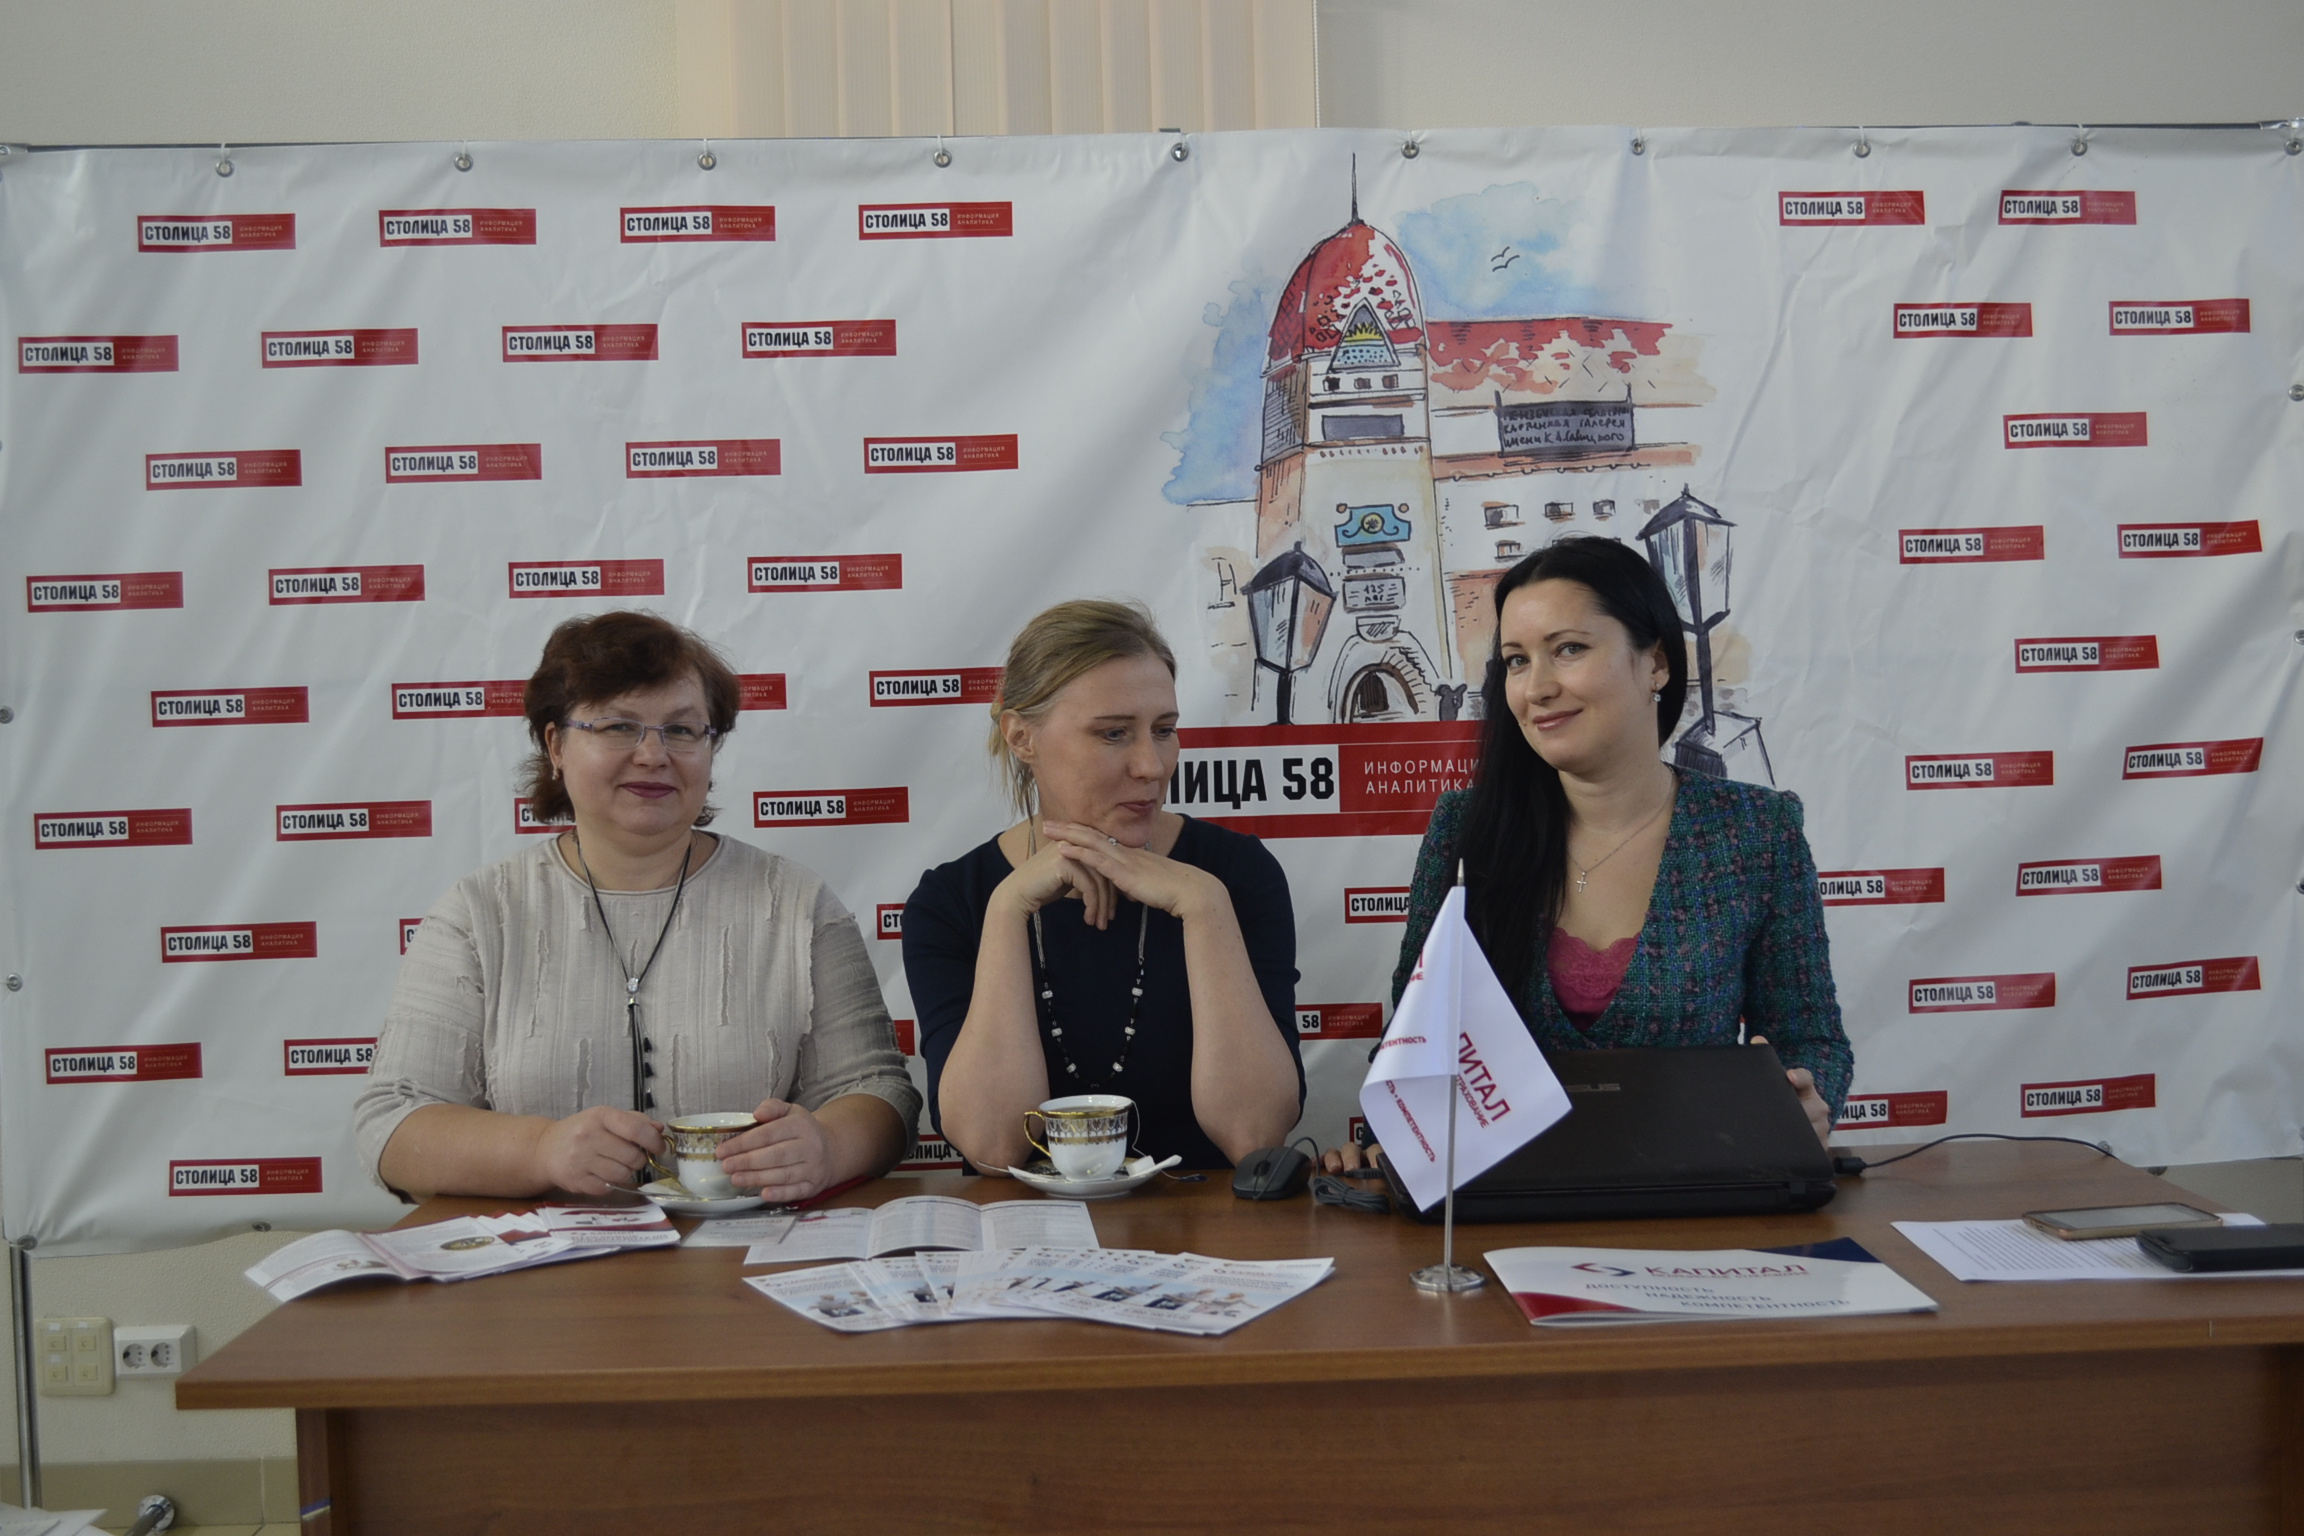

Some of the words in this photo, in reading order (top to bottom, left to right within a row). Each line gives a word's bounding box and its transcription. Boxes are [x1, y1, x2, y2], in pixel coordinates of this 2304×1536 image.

[1785, 201, 1843, 217] СТОЛИЦА
[1847, 201, 1863, 215] 58
[2002, 201, 2058, 216] СТОЛИЦА
[2062, 200, 2079, 214] 58
[386, 219, 448, 236] СТОЛИЦА
[453, 219, 471, 233] 58
[627, 216, 688, 233] СТОЛИЦА
[693, 215, 710, 230] 58
[865, 213, 927, 230] СТОЛИЦА
[931, 212, 948, 227] 58
[145, 226, 208, 242] СТОЛИЦА
[214, 225, 231, 239] 58
[1899, 312, 1956, 328] СТОЛИЦА
[1961, 312, 1976, 326] 58
[2115, 311, 2171, 325] СТОЛИЦА
[2175, 310, 2192, 324] 58
[268, 340, 330, 357] СТОЛИЦА
[335, 340, 353, 354] 58
[509, 335, 571, 352] СТОЛИЦА
[575, 335, 593, 349] 58
[748, 331, 810, 348] СТОЛИЦА
[814, 331, 832, 345] 58
[25, 346, 88, 364] СТОЛИЦА
[94, 346, 112, 361] 58
[2010, 423, 2069, 438] СТОЛИЦА
[2073, 422, 2088, 436] 58
[392, 456, 454, 472] СТОЛИЦА
[459, 455, 476, 470] 58
[632, 451, 694, 468] СТОЛИЦА
[698, 450, 716, 465] 58
[870, 446, 932, 464] СТОЛИЦА
[937, 446, 954, 461] 58
[152, 462, 213, 479] СТОЛИЦА
[218, 462, 235, 476] 58
[1905, 538, 1961, 554] СТОЛИЦА
[1965, 537, 1982, 551] 58
[2123, 533, 2179, 549] СТОЛИЦА
[2183, 532, 2199, 546] 58
[515, 571, 578, 588] СТОЛИЦА
[581, 570, 599, 585] 58
[754, 566, 816, 583] СТОЛИЦА
[820, 565, 838, 580] 58
[33, 585, 97, 602] СТОЛИЦА
[102, 584, 119, 599] 58
[275, 577, 337, 594] СТОЛИЦА
[342, 577, 359, 591] 58
[2021, 647, 2078, 663] СТОЛИЦА
[2082, 646, 2098, 660] 58
[876, 679, 938, 697] СТОЛИЦА
[942, 678, 960, 694] 58
[158, 699, 221, 716] СТОЛИЦА
[225, 698, 243, 713] 58
[398, 691, 461, 709] СТОЛИЦА
[465, 691, 483, 706] 58
[1363, 758, 1479, 775] ИНФОРМАЦИ
[2128, 753, 2182, 769] СТОЛИЦА
[2186, 751, 2203, 765] 58
[1282, 757, 1335, 801] 58
[1912, 763, 1971, 780] СТОЛИЦА
[1975, 763, 1992, 777] 58
[760, 800, 823, 817] СТОЛИЦА
[826, 799, 845, 815] 58
[41, 821, 104, 838] СТОЛИЦА
[109, 820, 127, 836] 58
[283, 813, 345, 830] СТОЛИЦА
[349, 812, 367, 827] 58
[2022, 869, 2078, 885] СТОЛИЦА
[2082, 868, 2099, 882] 58
[1819, 880, 1863, 897] ОЛИЦА
[1866, 880, 1884, 894] 58
[168, 935, 229, 952] СТОЛИЦА
[233, 934, 251, 949] 58
[2132, 971, 2182, 989] СТОЛИЦА
[2186, 969, 2201, 984] 58
[1914, 986, 1973, 1003] СТОЛИЦА
[1977, 985, 1994, 999] 58
[1301, 1014, 1320, 1029] 58
[52, 1056, 115, 1073] СТОЛИЦА
[119, 1055, 136, 1070] 58
[290, 1048, 352, 1065] СТОЛИЦА
[355, 1047, 373, 1062] 58
[1458, 1031, 1511, 1122] ПИТАЛ
[1456, 1073, 1489, 1129] ТРАХОВАНИЕ
[2026, 1090, 2082, 1107] СТОЛИЦА
[2086, 1088, 2101, 1103] 58
[1870, 1103, 1887, 1117] 58
[175, 1169, 236, 1186] СТОЛИЦА
[240, 1168, 258, 1183] 58
[1645, 1264, 1806, 1275] КАПИТАЛ
